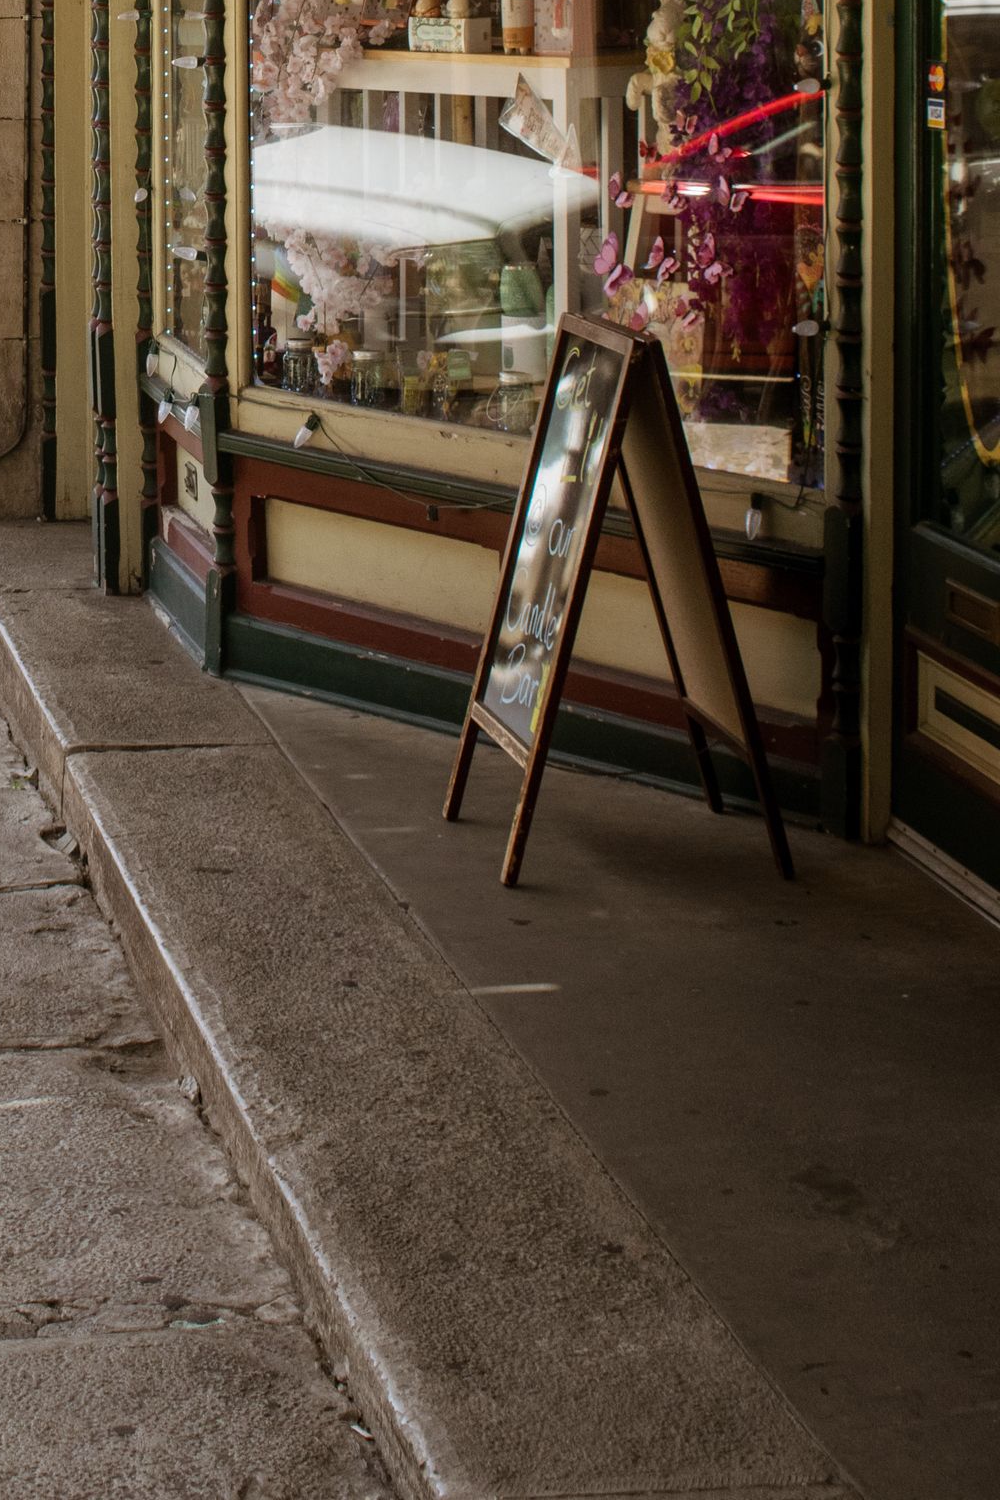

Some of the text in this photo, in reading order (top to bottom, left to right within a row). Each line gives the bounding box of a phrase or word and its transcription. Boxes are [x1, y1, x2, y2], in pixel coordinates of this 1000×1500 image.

[556, 346, 597, 411] Get
[548, 518, 577, 559] our
[506, 567, 559, 652] Candle
